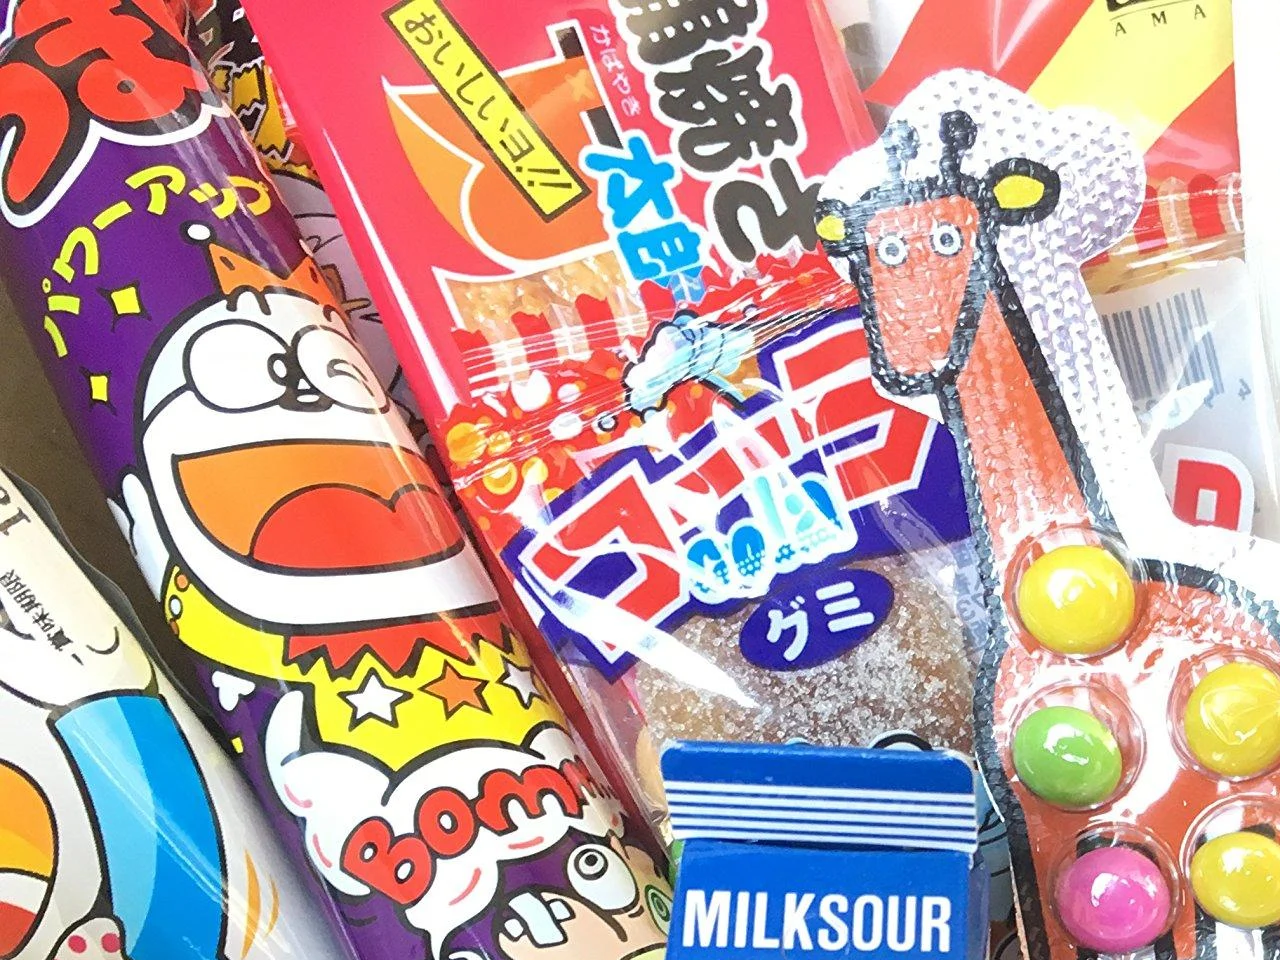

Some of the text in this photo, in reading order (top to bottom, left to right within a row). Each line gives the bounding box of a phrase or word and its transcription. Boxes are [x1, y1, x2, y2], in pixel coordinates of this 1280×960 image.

[590, 24, 642, 118] かばやき
[41, 164, 272, 356] パワーアップ
[766, 578, 875, 662] グミ
[682, 889, 951, 952] MILKSOUR
